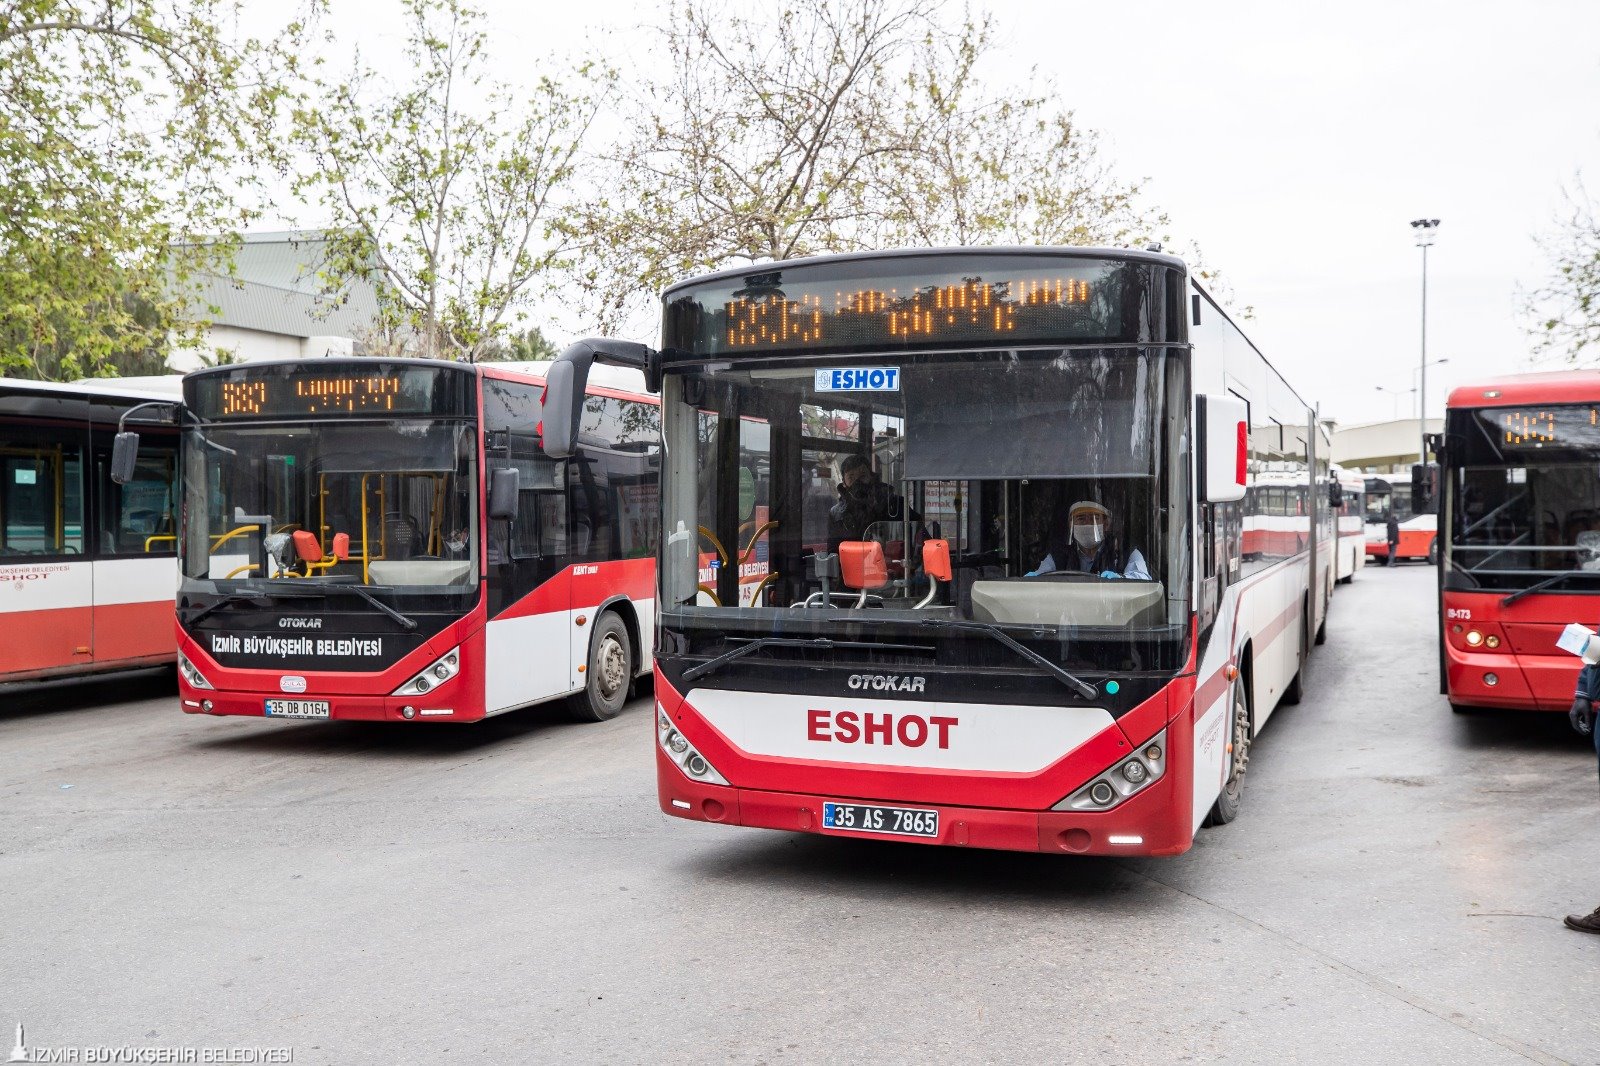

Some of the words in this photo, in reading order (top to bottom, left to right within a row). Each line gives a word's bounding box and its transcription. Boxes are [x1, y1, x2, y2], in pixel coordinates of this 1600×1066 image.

[831, 370, 897, 389] ESHOT
[32, 565, 70, 573] BELEDİYESİ
[278, 618, 322, 628] OTOKAR
[212, 634, 241, 653] İZMİR
[243, 635, 314, 658] BÜYÜKŞEHİR
[316, 637, 382, 656] BELEDİYESİ
[848, 674, 926, 692] OTOKAR
[272, 701, 284, 713] 35
[287, 702, 299, 714] DB
[303, 703, 327, 715] 0164
[807, 709, 959, 749] ESHOT
[835, 806, 855, 827] 35
[862, 808, 883, 829] AS
[893, 810, 936, 833] 7865
